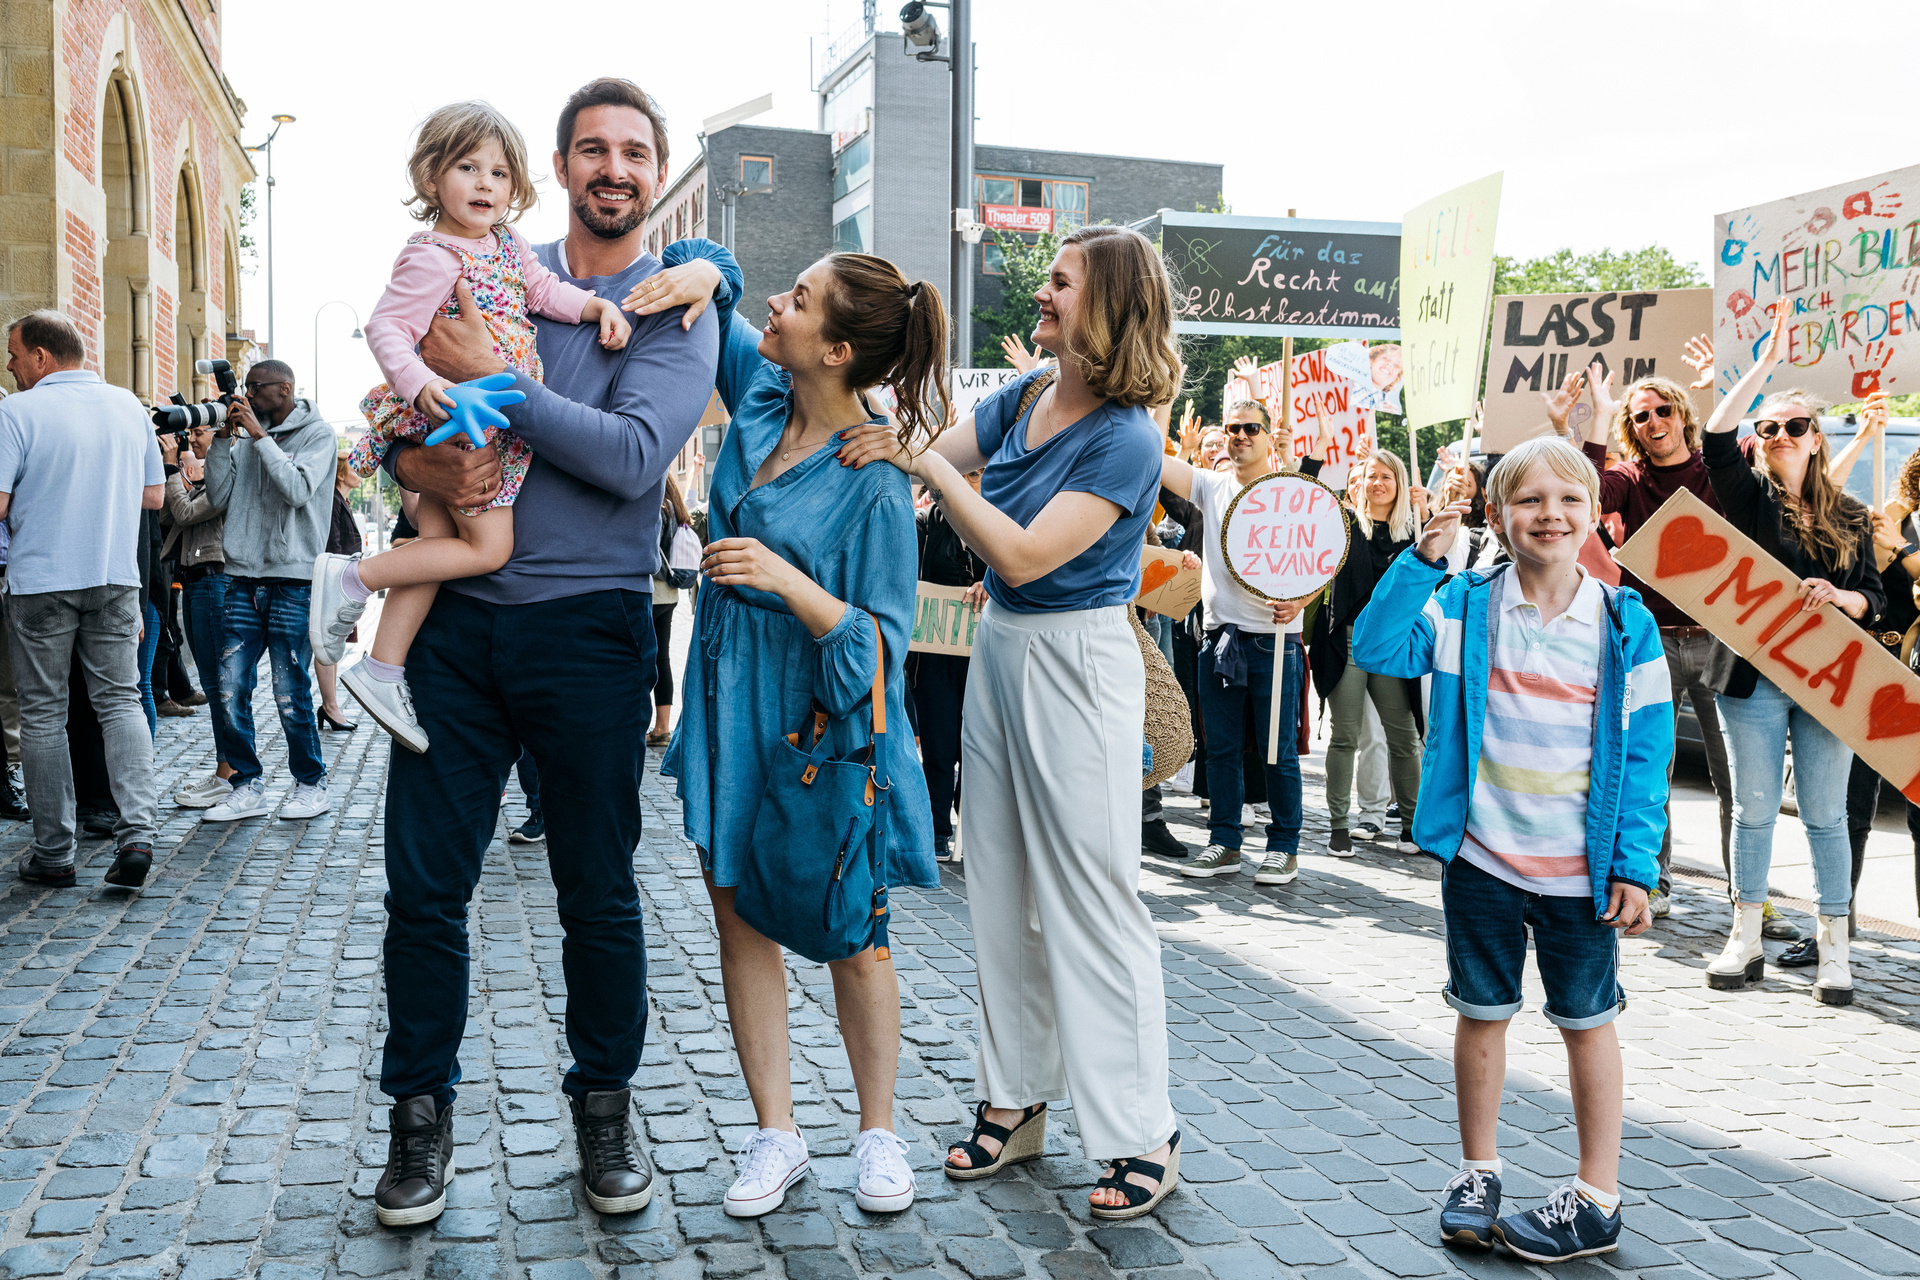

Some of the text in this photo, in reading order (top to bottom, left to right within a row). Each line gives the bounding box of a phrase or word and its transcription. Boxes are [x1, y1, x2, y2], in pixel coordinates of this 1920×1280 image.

[986, 209, 1050, 225] Theater 509
[1252, 234, 1362, 264] Für das
[1753, 239, 1849, 300] MEHR
[1237, 257, 1400, 304] Recht auf
[1418, 281, 1454, 324] statt
[1504, 292, 1658, 347] LASST
[1410, 335, 1459, 397] Einfalt
[1623, 357, 1656, 386] IN
[1241, 549, 1335, 577] ZWANG
[1704, 556, 1863, 708] MILA
